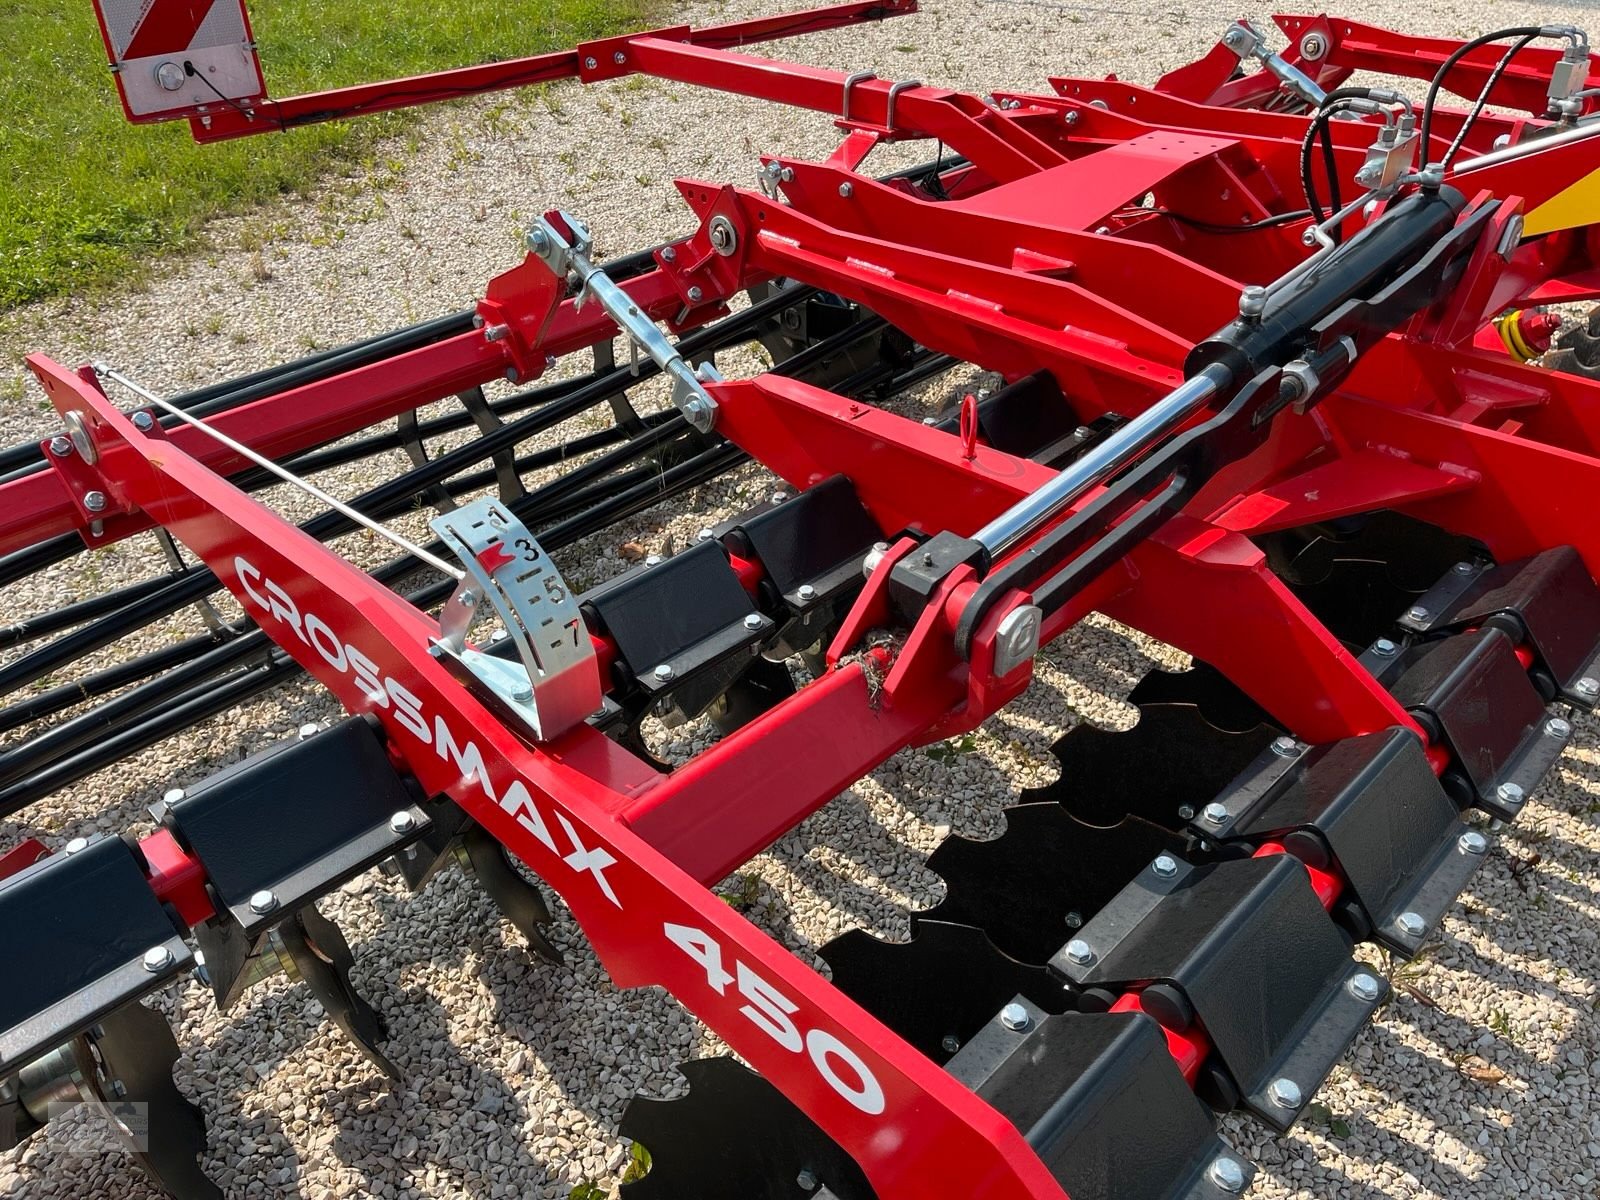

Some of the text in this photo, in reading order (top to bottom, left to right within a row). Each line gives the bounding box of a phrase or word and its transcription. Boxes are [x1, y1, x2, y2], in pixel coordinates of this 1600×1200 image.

[488, 505, 509, 524] 1
[515, 538, 540, 562] 3
[543, 575, 567, 606] 5
[563, 618, 579, 648] 7
[234, 555, 886, 1116] CROSSMAX 450
